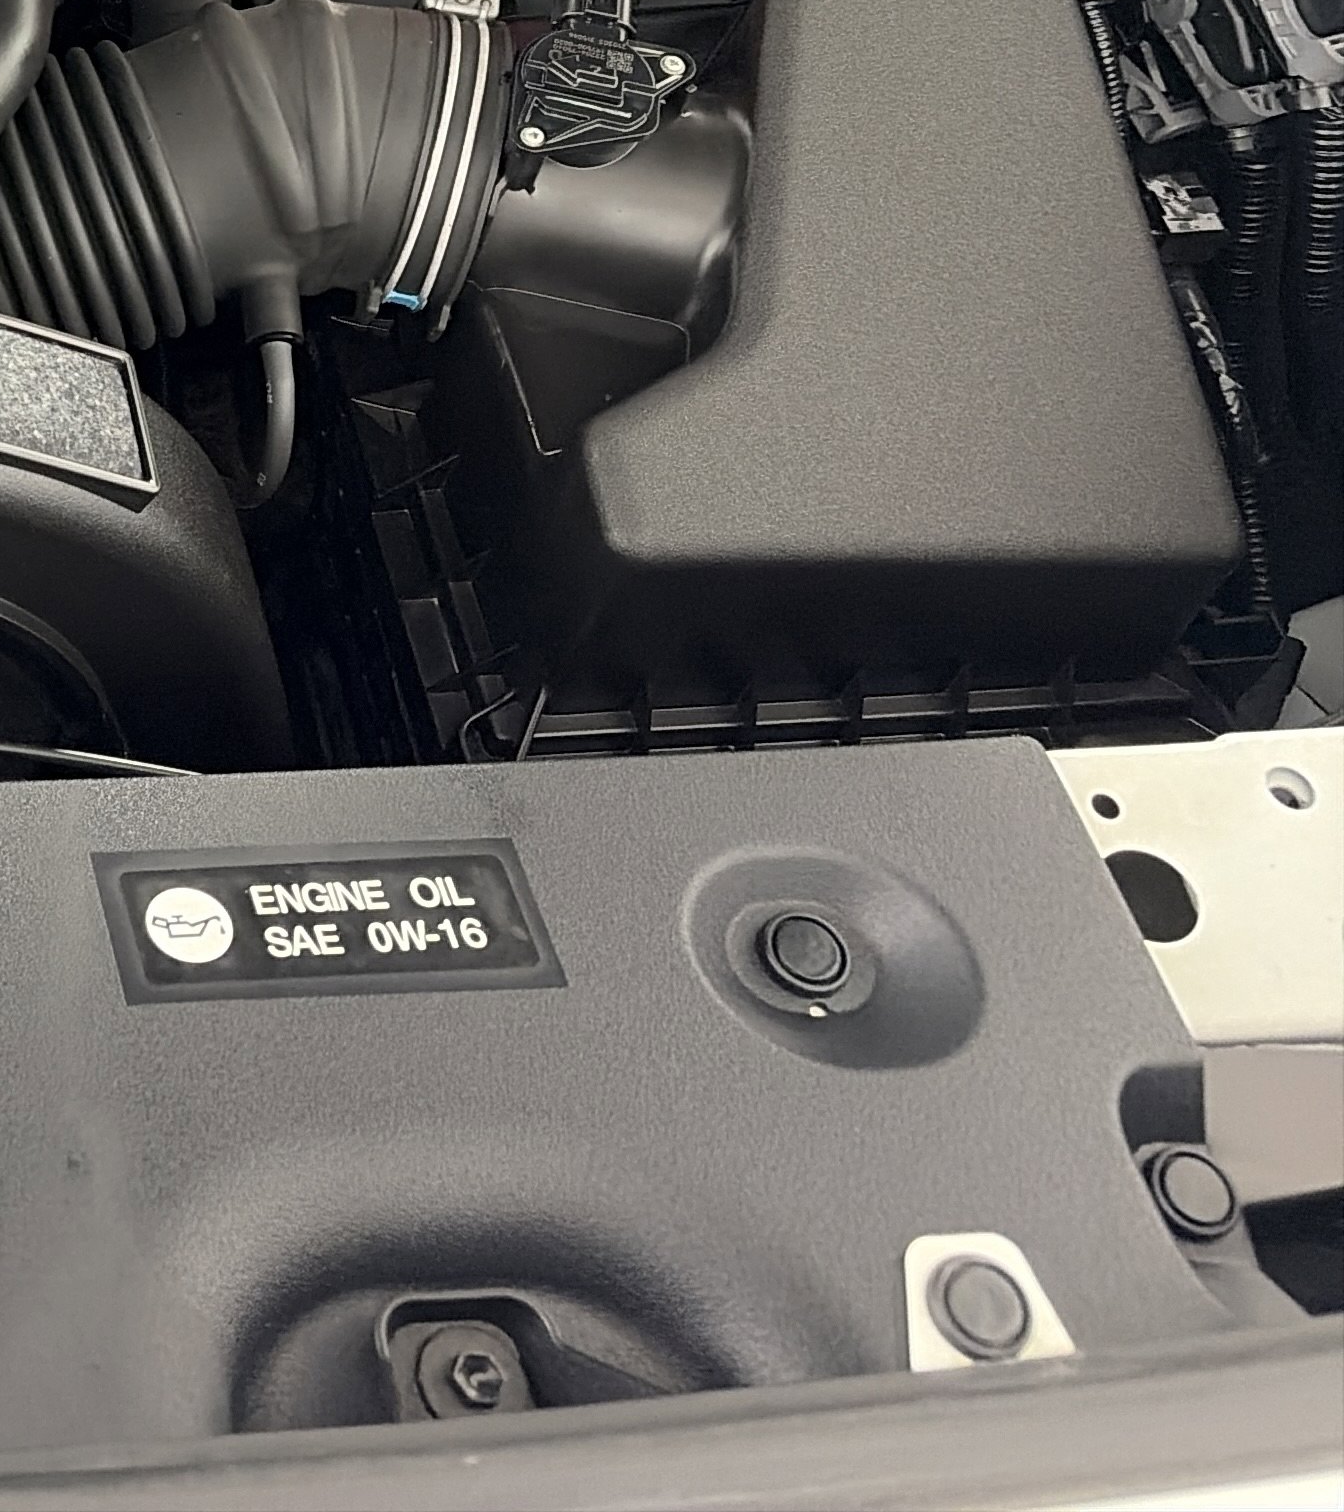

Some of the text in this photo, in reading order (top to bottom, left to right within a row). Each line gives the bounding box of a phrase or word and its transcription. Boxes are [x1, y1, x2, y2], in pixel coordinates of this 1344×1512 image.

[249, 875, 476, 918] ENGINE OIL
[264, 917, 489, 959] SAE 0W-16
